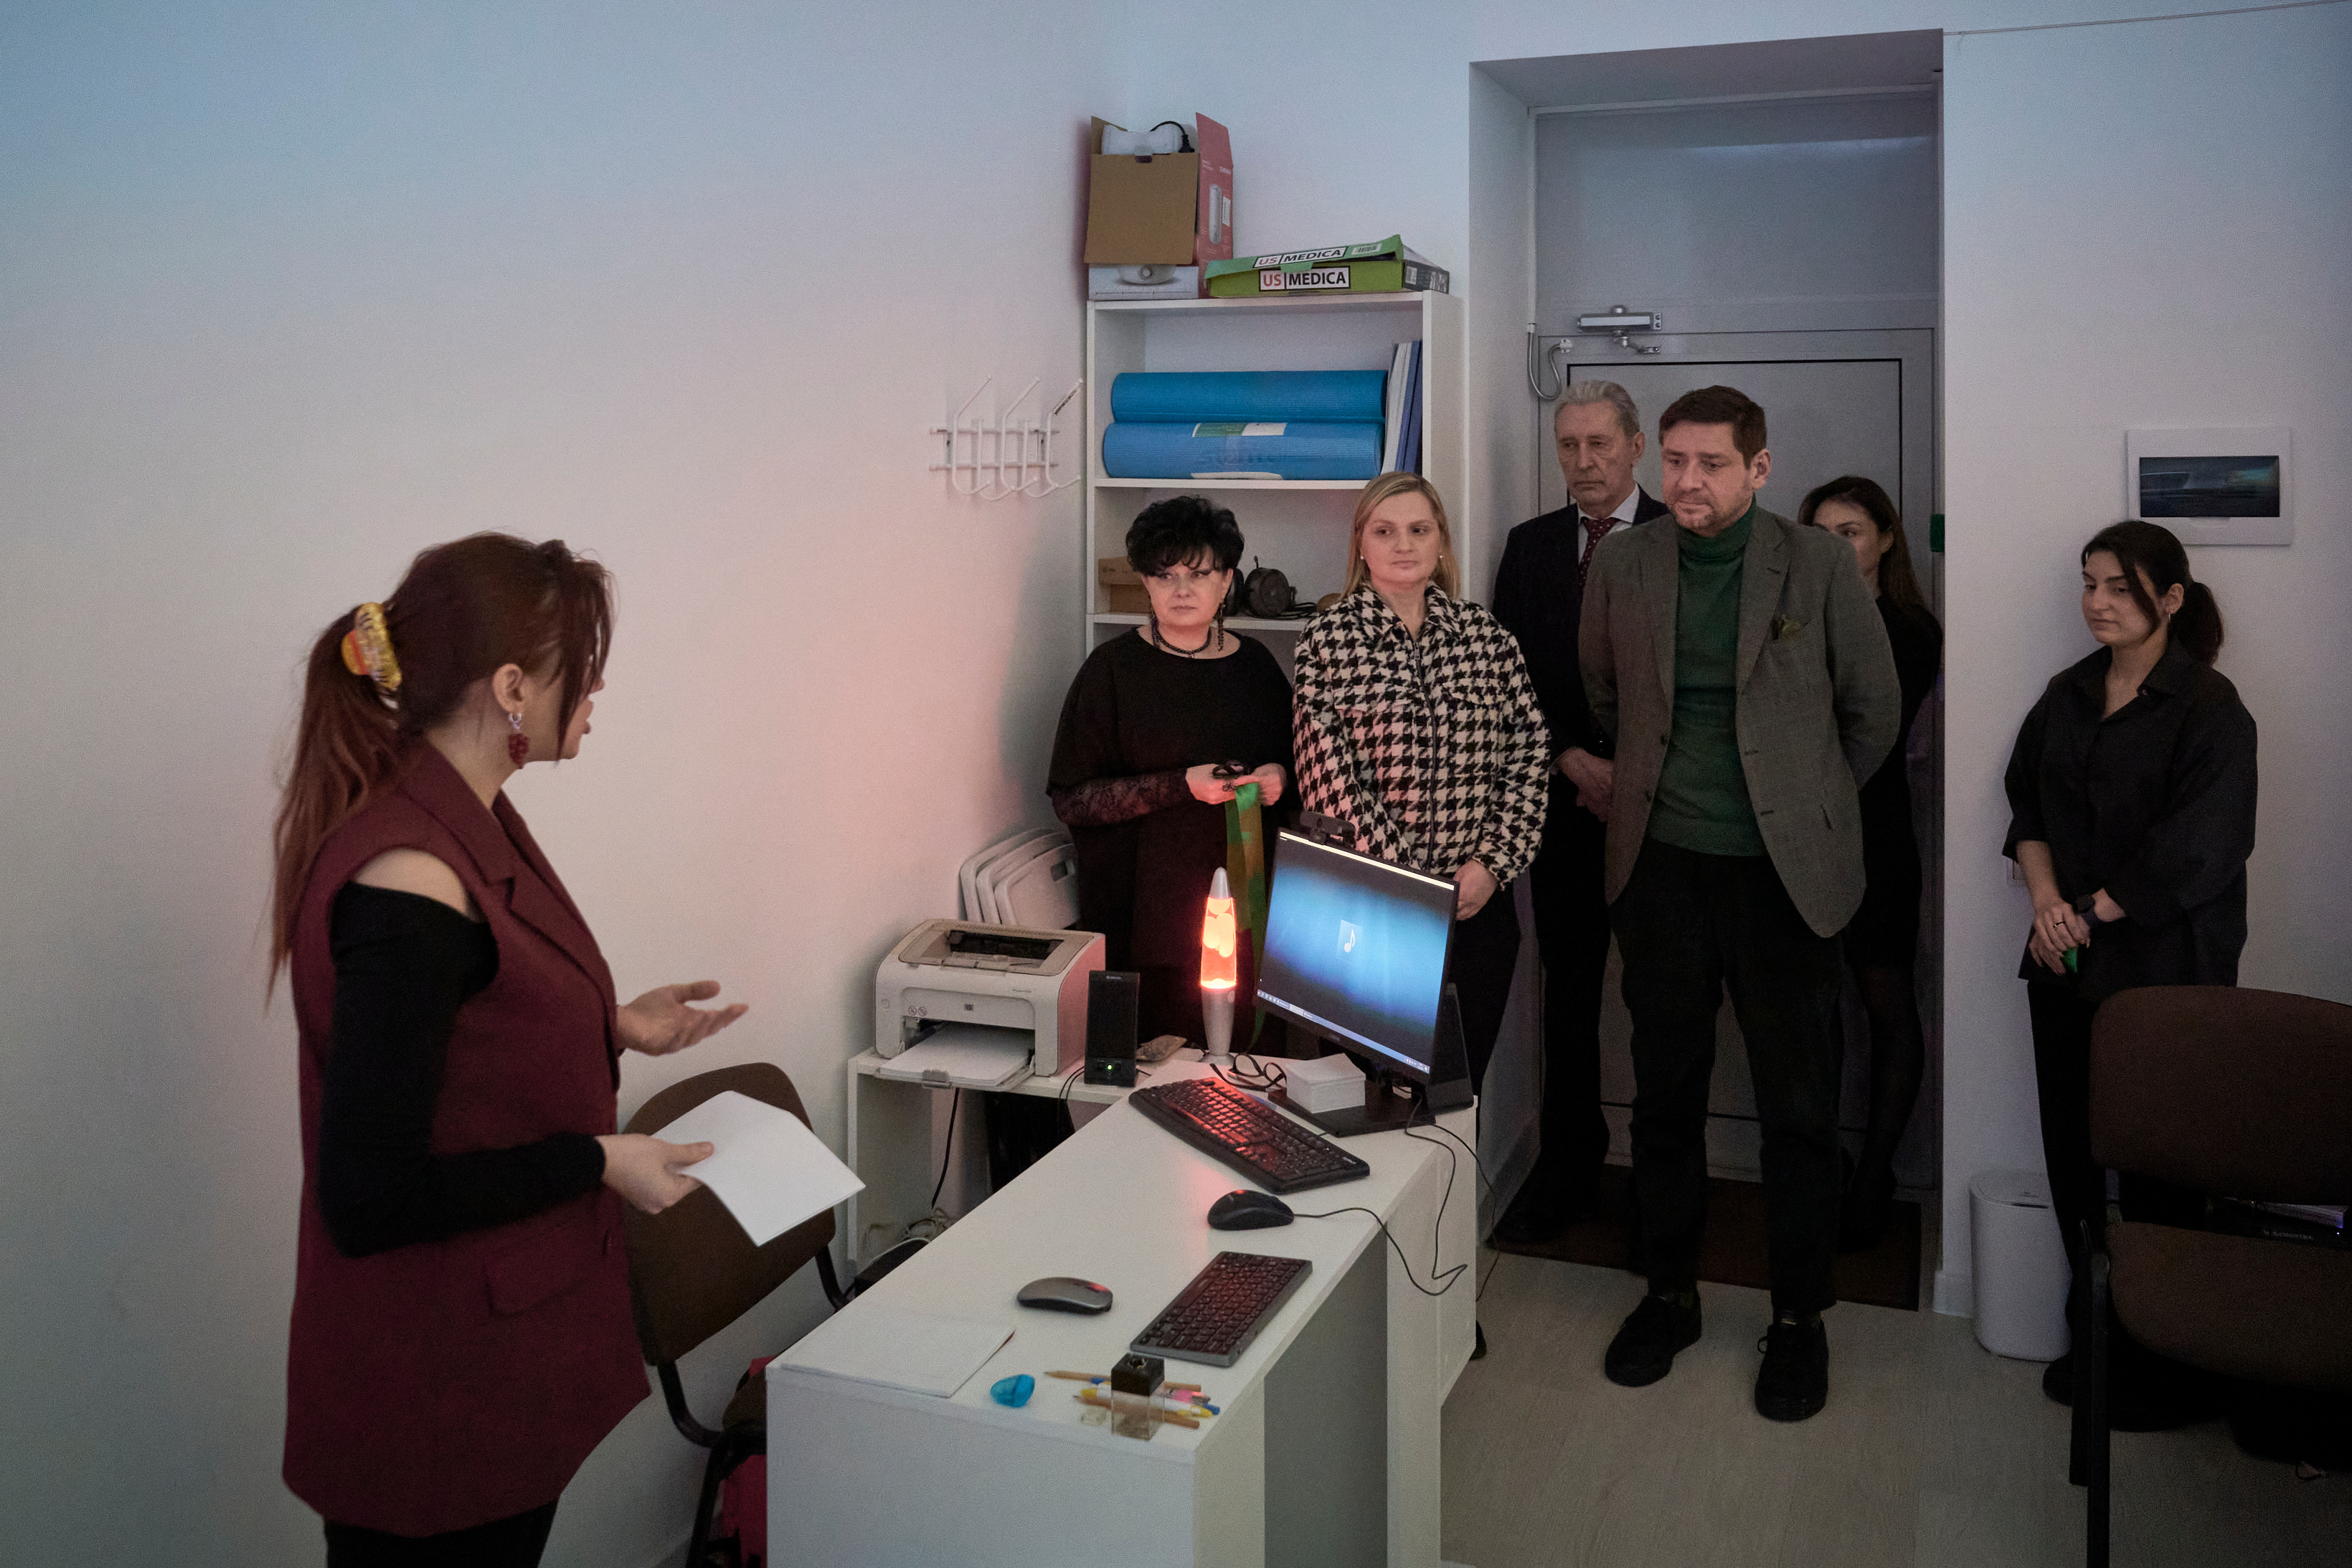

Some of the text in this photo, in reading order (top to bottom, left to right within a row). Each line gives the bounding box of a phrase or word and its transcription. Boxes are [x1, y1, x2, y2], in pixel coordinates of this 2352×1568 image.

[1284, 250, 1341, 262] MEDICA
[1263, 272, 1346, 287] US MEDICA
